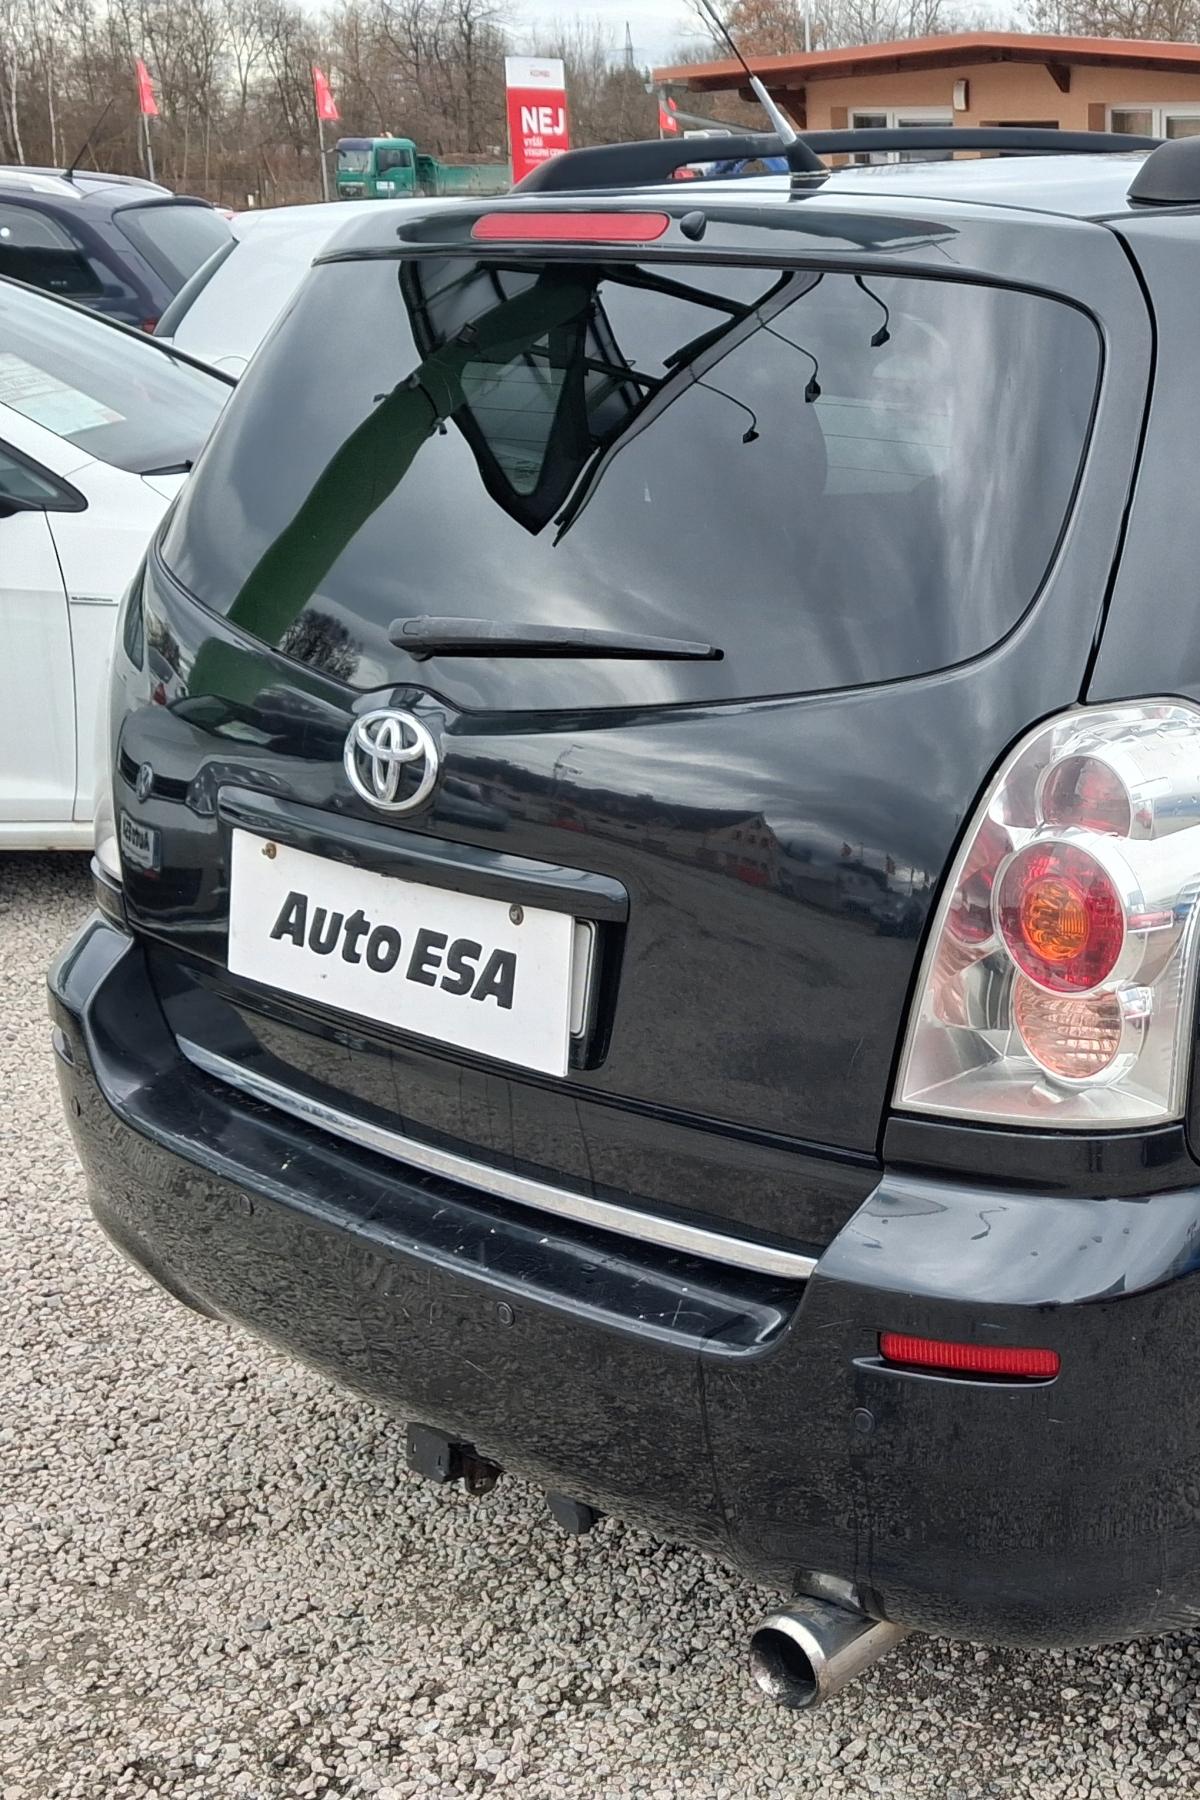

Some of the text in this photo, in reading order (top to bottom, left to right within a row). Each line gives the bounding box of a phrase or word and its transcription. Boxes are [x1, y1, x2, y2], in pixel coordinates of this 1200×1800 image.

[520, 105, 565, 136] NEJ
[269, 891, 517, 1010] Auto ESA
